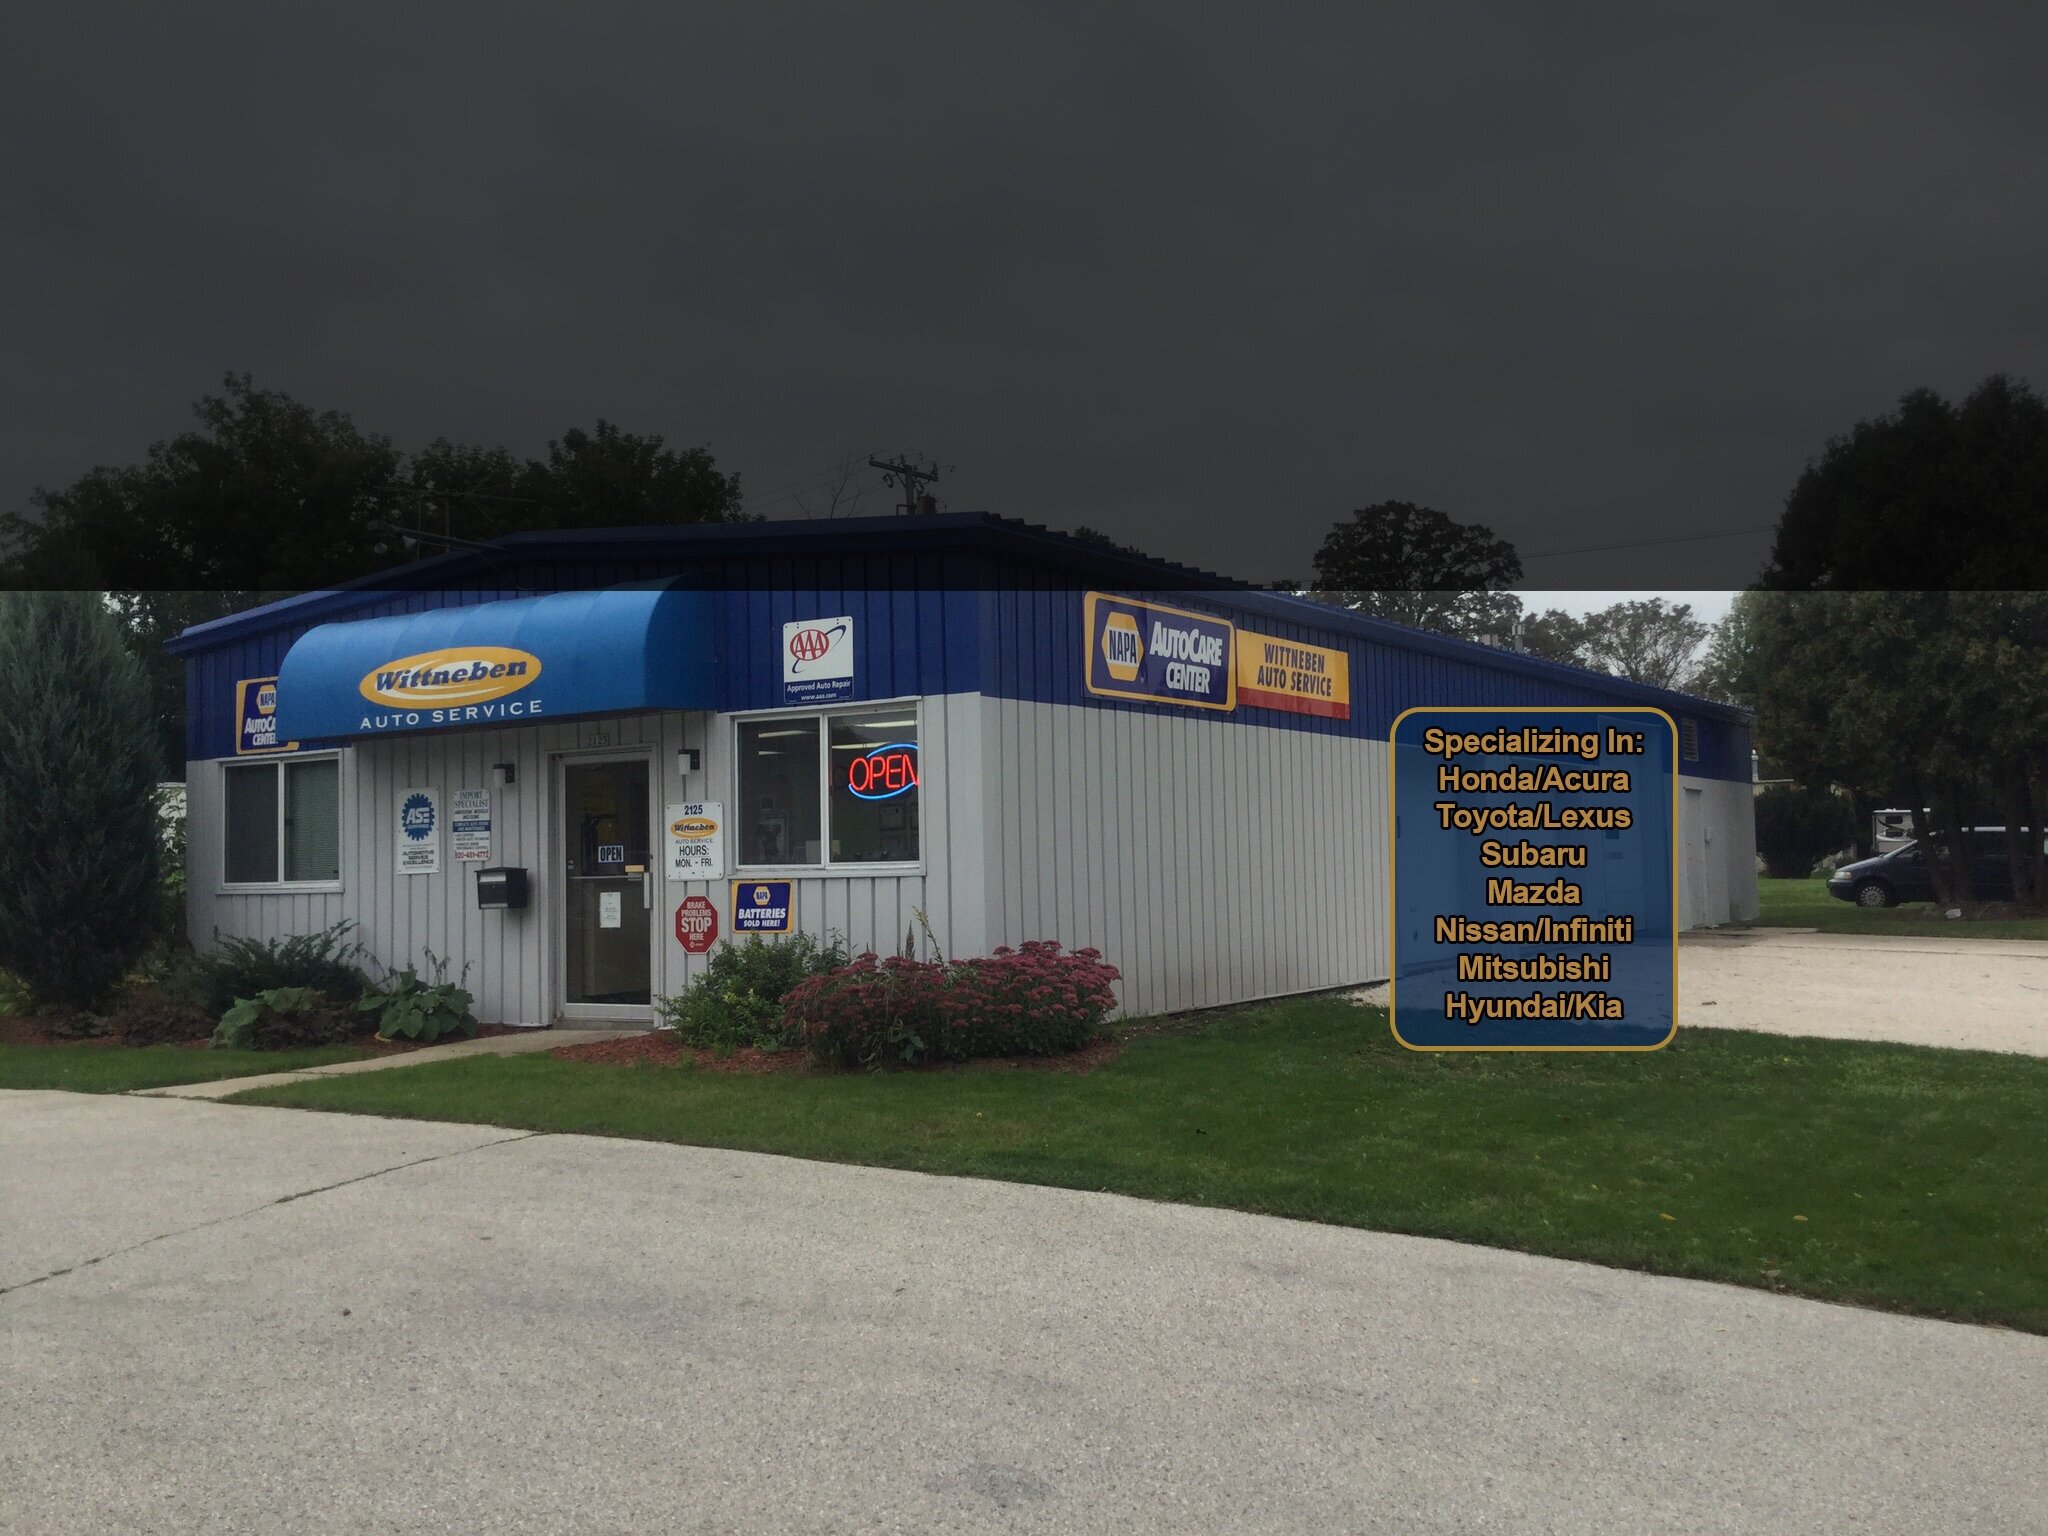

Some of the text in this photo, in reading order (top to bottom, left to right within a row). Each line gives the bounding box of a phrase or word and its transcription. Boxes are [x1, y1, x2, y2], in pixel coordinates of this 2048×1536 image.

[792, 629, 827, 660] AAA
[1109, 630, 1137, 664] NAPA
[1264, 643, 1325, 673] WITTNEBEN
[376, 661, 527, 691] Wittneben
[1166, 661, 1211, 694] CENTER
[1257, 665, 1332, 697] AUTO SERVICE
[786, 680, 851, 693] Approved Auto Repair
[360, 700, 542, 730] AUTO SERVICE
[849, 755, 919, 791] OPEN
[406, 807, 430, 824] ASE
[684, 805, 703, 815] 2125
[600, 847, 622, 861] OPEN
[679, 845, 709, 856] HOURS:
[675, 859, 693, 868] MON.
[700, 858, 713, 867] FRI.
[756, 892, 768, 900] NAPA
[686, 901, 706, 909] BRAKE
[681, 909, 712, 917] PROBLEMS
[738, 908, 786, 919] BATTERIES
[681, 917, 712, 933] STOP
[743, 919, 780, 927] SOLD HERE!
